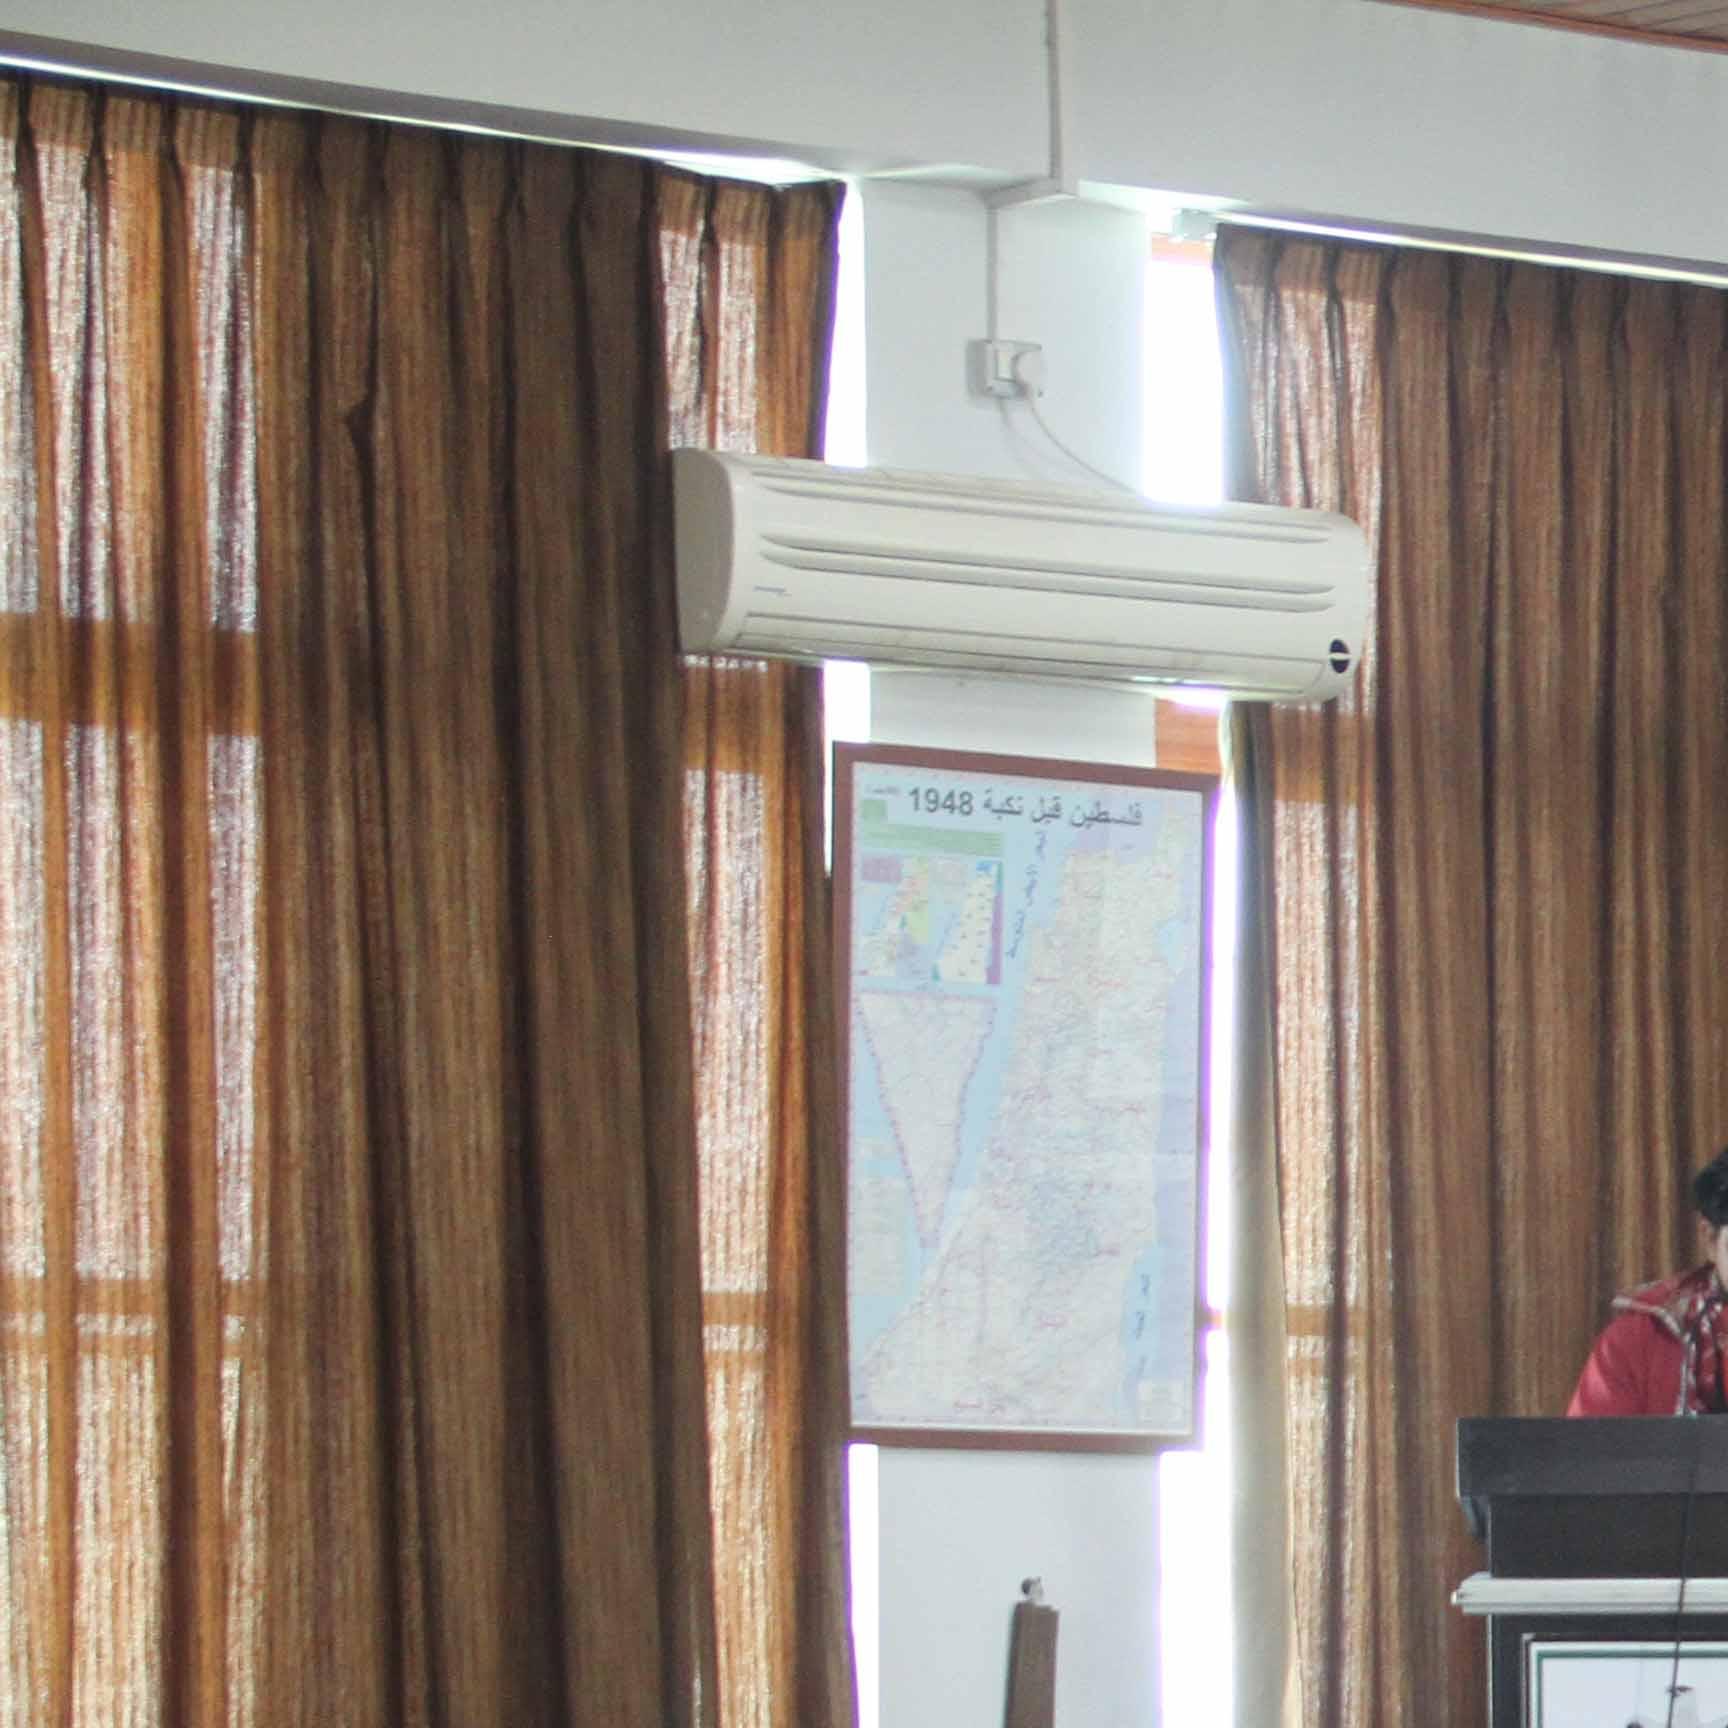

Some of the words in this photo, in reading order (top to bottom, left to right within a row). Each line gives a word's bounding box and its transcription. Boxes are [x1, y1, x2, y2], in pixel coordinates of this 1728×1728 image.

[909, 787, 974, 816] 1948
[984, 788, 1023, 820] نكبة
[1031, 796, 1062, 823] قبل
[1070, 801, 1143, 828] فلسطين
